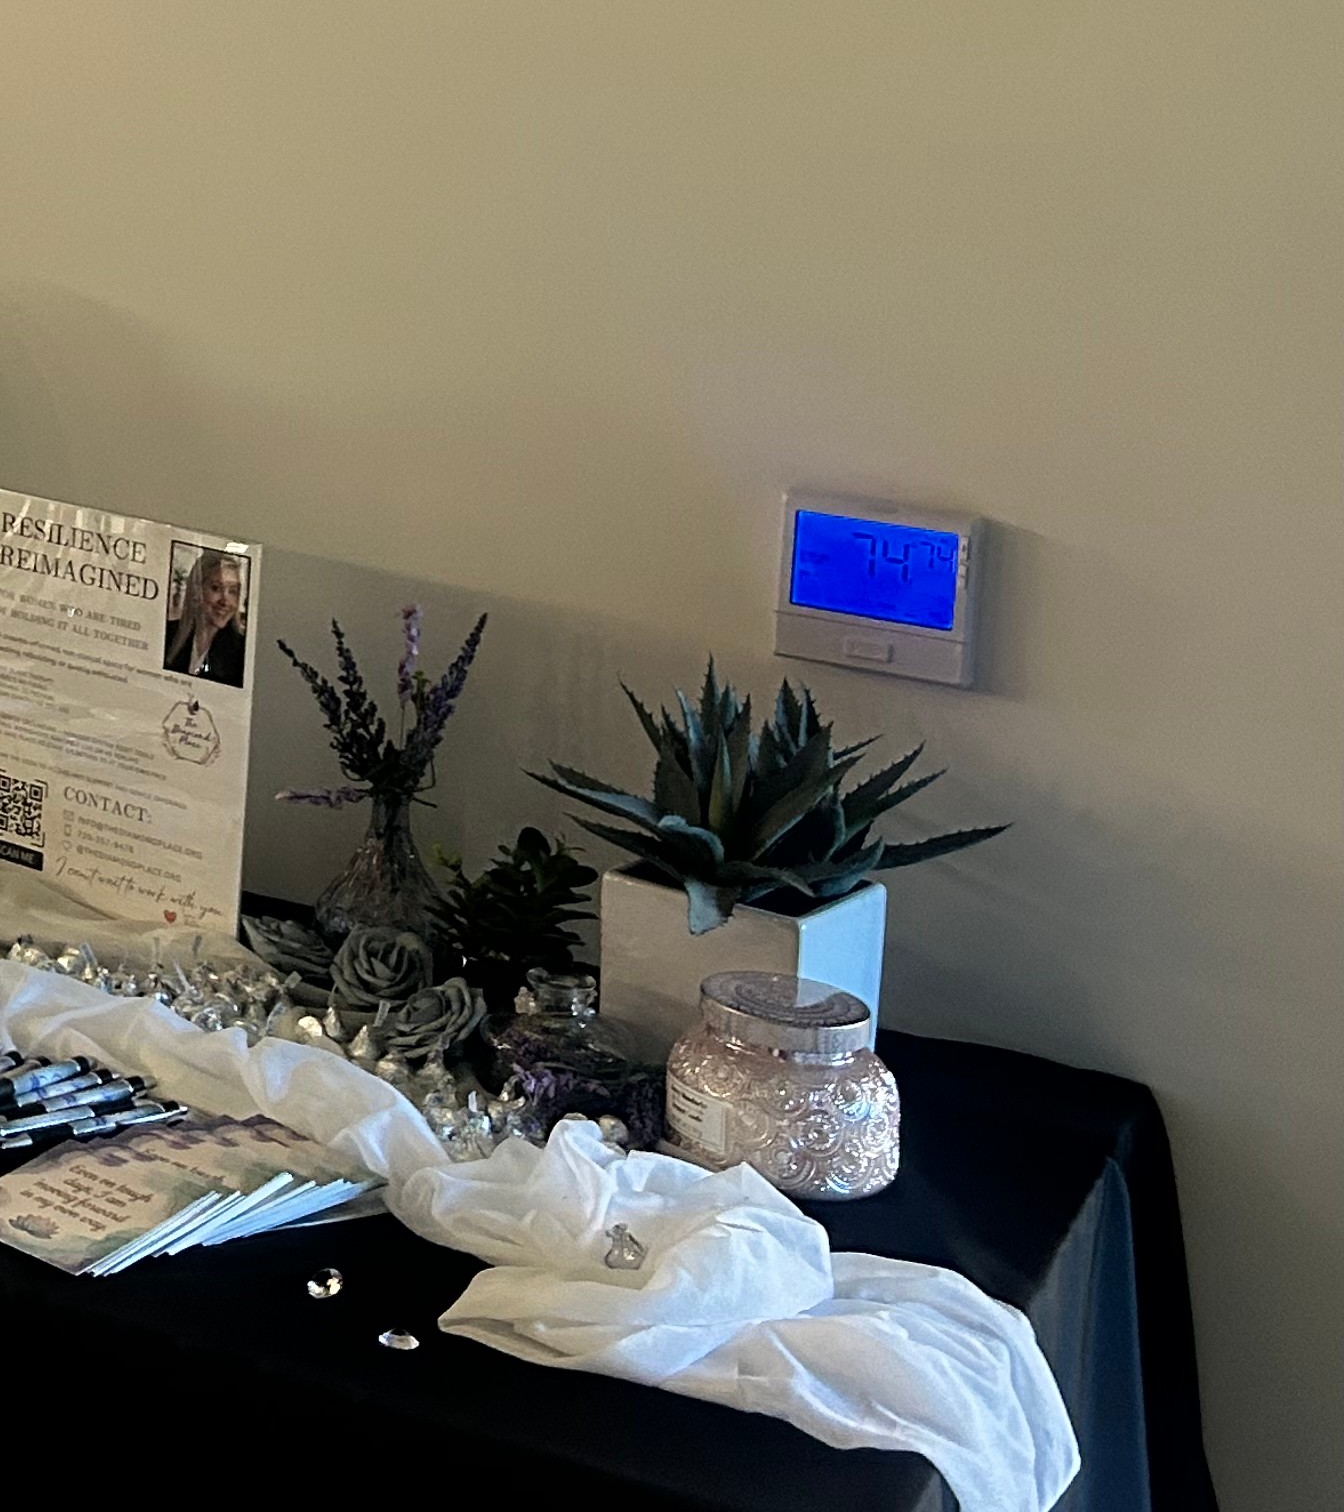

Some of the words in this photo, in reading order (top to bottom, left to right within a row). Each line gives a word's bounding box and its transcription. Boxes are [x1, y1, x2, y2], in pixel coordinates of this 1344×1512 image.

[2, 511, 147, 565] RESILIENCE
[852, 531, 911, 584] 74
[63, 786, 153, 825] CONTACT:
[21, 848, 36, 865] ME
